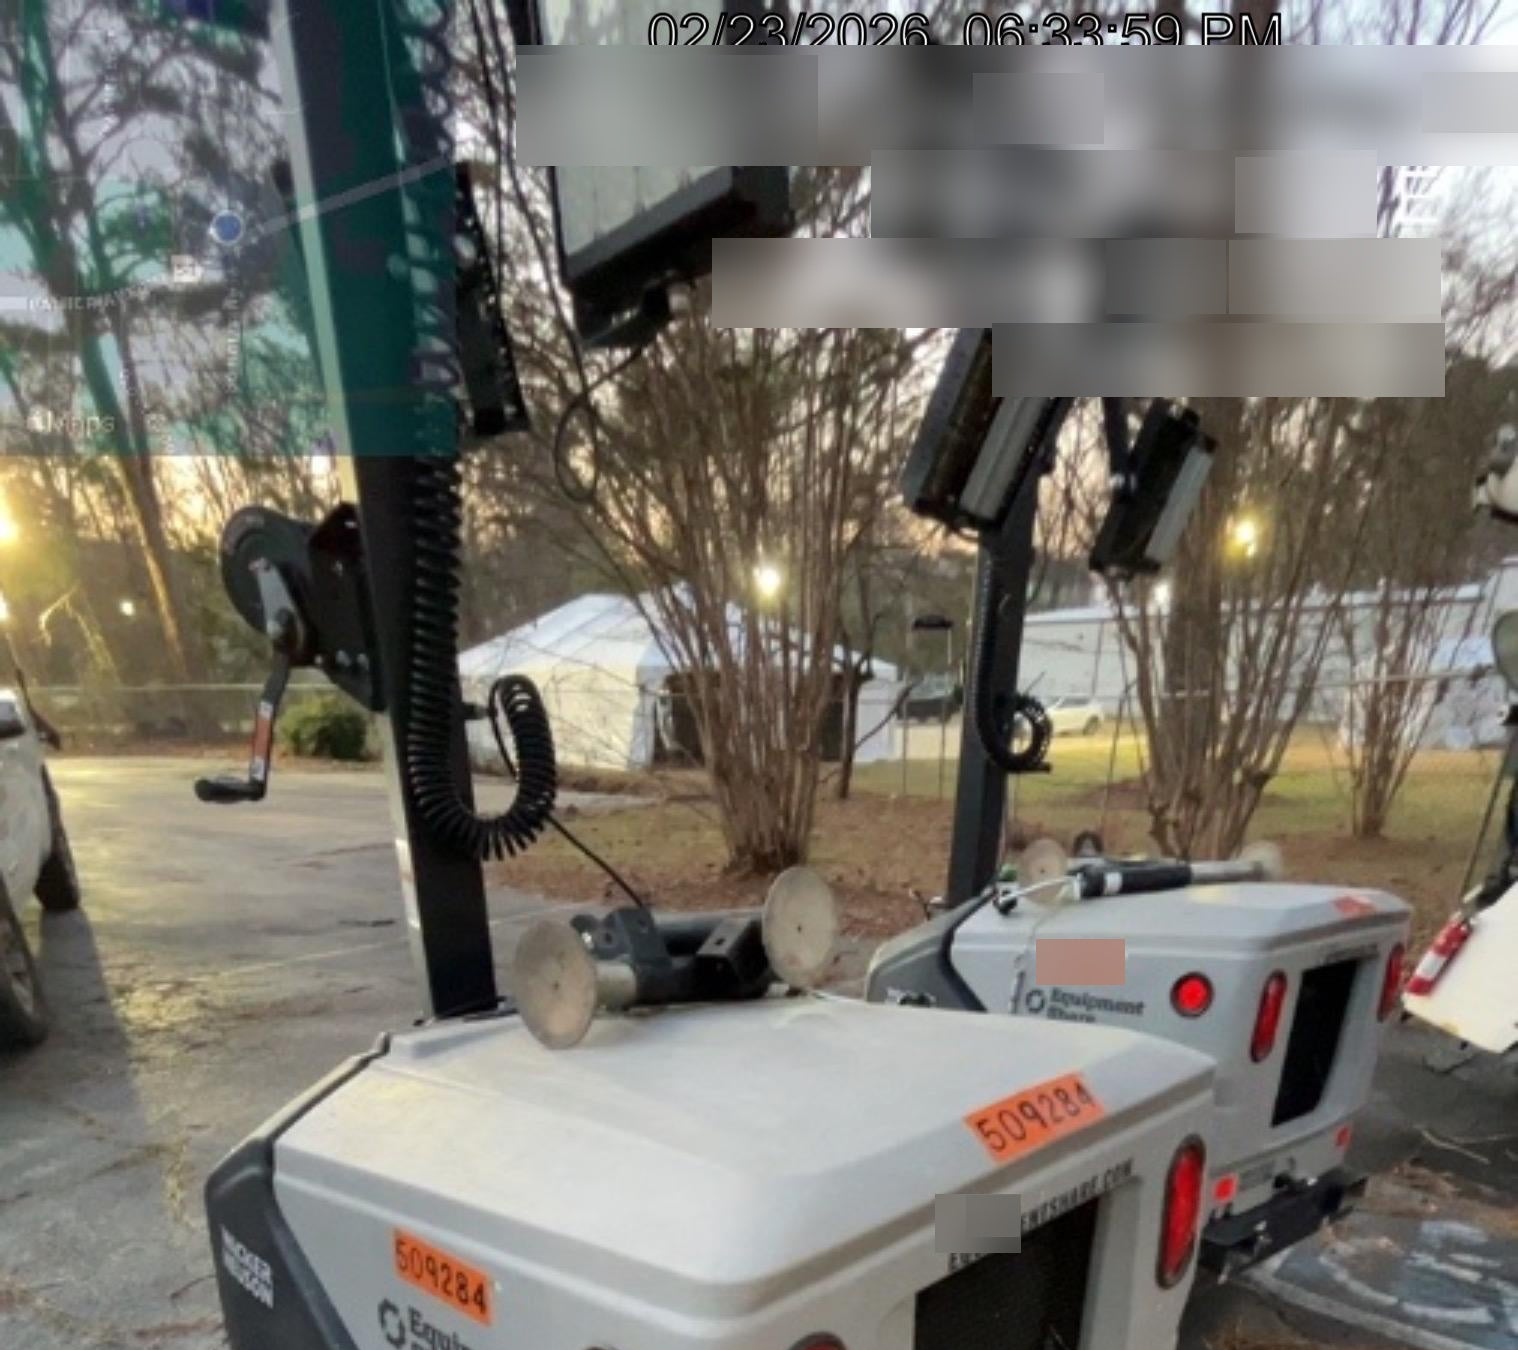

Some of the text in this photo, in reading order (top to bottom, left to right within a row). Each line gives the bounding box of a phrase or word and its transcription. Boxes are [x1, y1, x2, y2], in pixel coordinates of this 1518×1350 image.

[1050, 987, 1145, 1016] Equipment
[976, 1080, 1098, 1152] 509284
[394, 1240, 487, 1315] 509284
